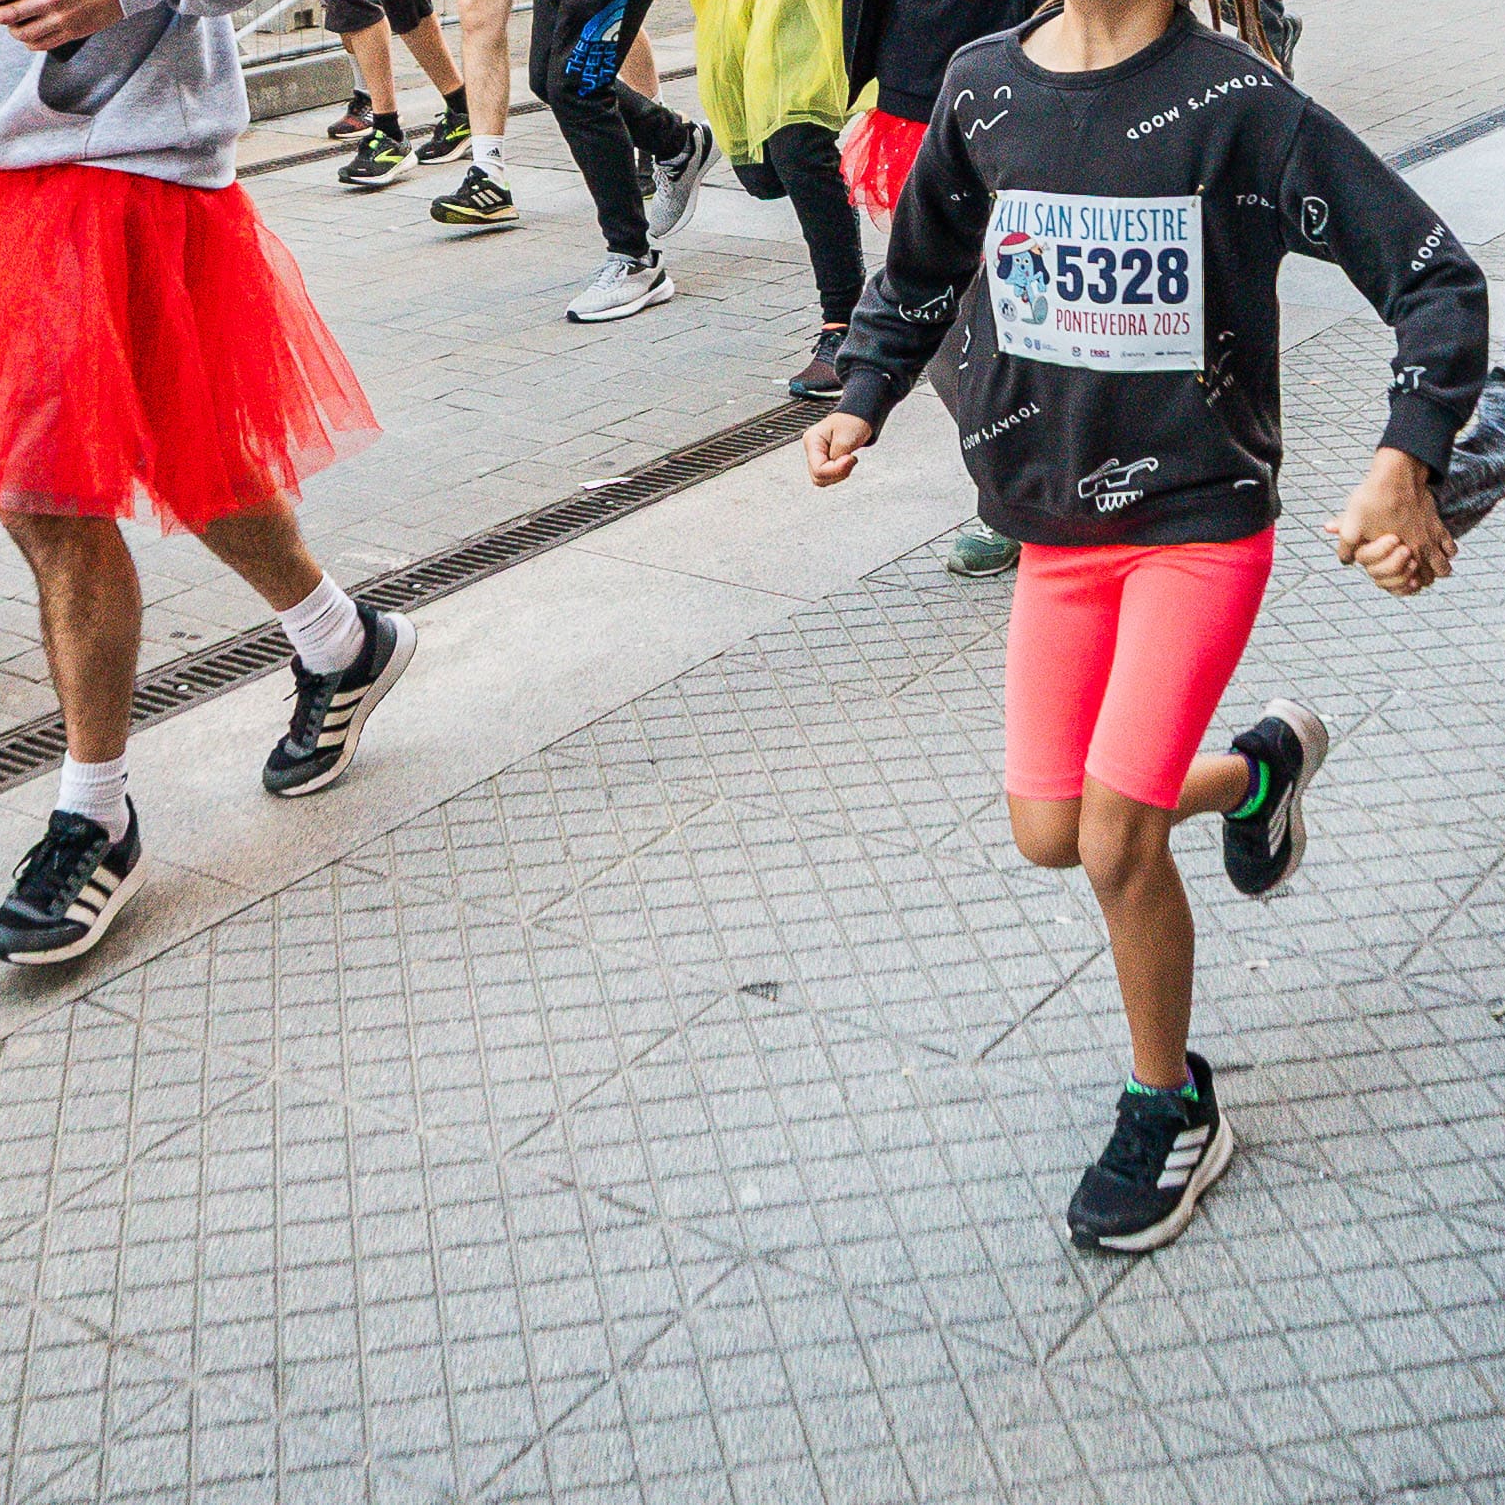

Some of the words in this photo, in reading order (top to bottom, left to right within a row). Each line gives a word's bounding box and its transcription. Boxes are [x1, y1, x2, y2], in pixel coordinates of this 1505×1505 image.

[565, 39, 591, 75] THE
[577, 43, 605, 97] SUPER
[1187, 73, 1275, 111] TODAY'S
[1126, 106, 1181, 140] MOOD
[994, 199, 1028, 233] XLII
[1033, 202, 1073, 238] SAN
[1080, 206, 1189, 243] SILVESTRE
[1410, 222, 1446, 272] MOOD
[1055, 244, 1190, 305] 5328
[1056, 309, 1148, 337] PONTEVEDRA
[1153, 312, 1191, 336] 2025
[981, 401, 1042, 441] TODAY'S
